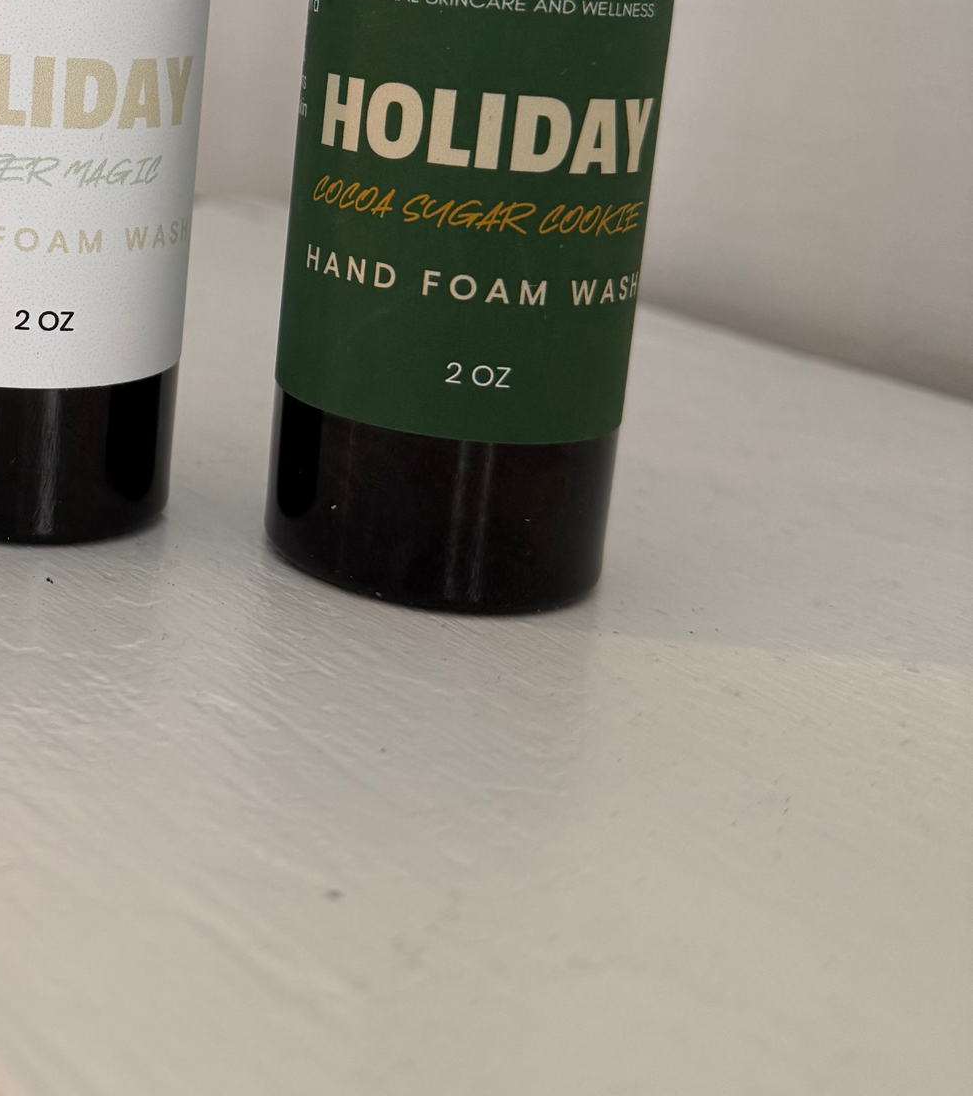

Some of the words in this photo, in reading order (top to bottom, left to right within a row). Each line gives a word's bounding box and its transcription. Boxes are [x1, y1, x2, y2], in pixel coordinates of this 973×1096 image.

[533, 0, 576, 15] AND
[582, 1, 655, 19] WELLNESS
[321, 72, 655, 174] HOLIDAY
[63, 154, 162, 188] MAGIC
[313, 175, 395, 222] COCOA
[402, 194, 536, 235] SUGAR
[539, 201, 643, 236] COOKIE
[125, 217, 189, 252] WASH
[306, 244, 397, 290] HAND
[422, 269, 547, 306] FOAM
[571, 271, 638, 306] WASH
[14, 310, 30, 331] 2
[38, 311, 75, 332] OZ
[445, 362, 462, 384] 2
[471, 365, 512, 388] OZ
